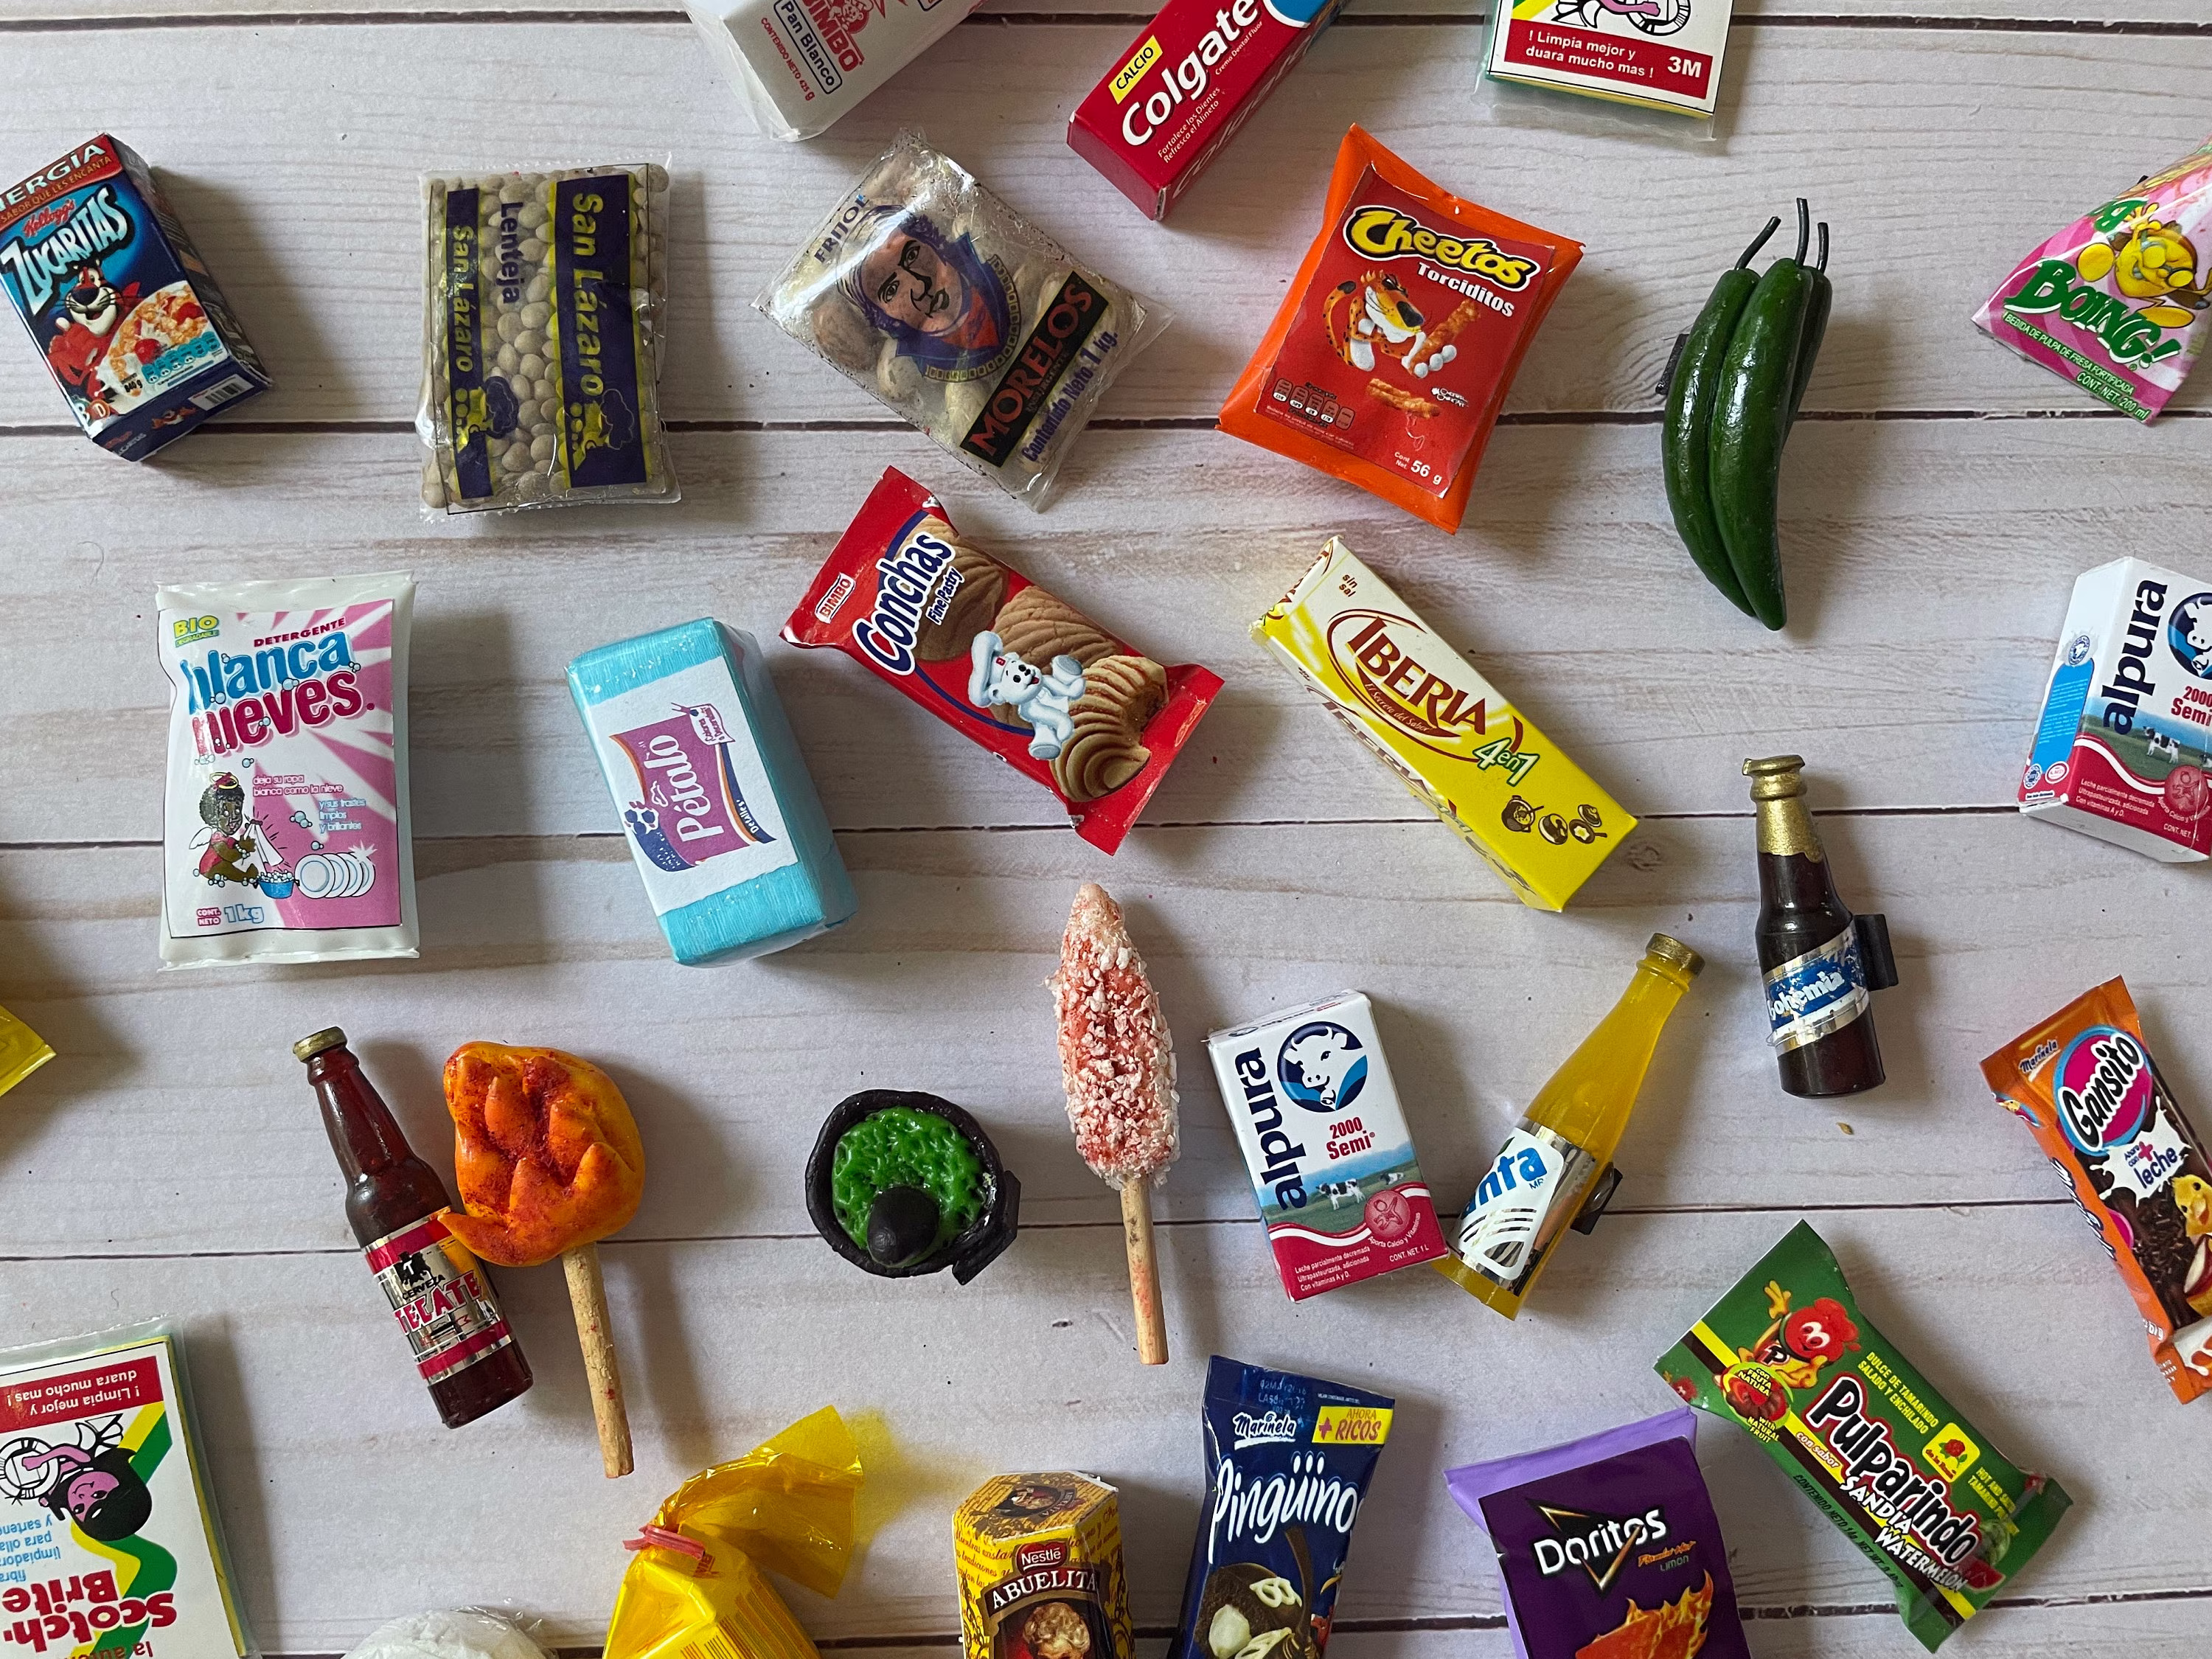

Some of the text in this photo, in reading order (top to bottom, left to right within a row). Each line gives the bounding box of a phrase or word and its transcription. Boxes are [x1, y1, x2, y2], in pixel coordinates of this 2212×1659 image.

[780, 3, 835, 86] Pan Blanco
[1231, 21, 1263, 58] Dental Fluor
[1537, 32, 1635, 60] Limpia mejor y
[761, 18, 790, 60] CONTENIDO
[787, 58, 801, 80] NETO
[805, 91, 815, 101] g
[1116, 46, 1154, 90] CALCIO
[1121, 0, 1258, 145] Colgate
[1526, 46, 1645, 76] duara mucho mas
[1668, 56, 1702, 78] 3M
[1158, 87, 1220, 158] Fortalece los Dientes
[1164, 130, 1192, 163] Refresca
[1189, 122, 1198, 134] el
[1, 156, 112, 223] SABOR QUE LES ENCANTA
[814, 195, 869, 264] FRIJOL
[1, 187, 128, 316] ZUCARITAS
[500, 201, 525, 305] Lenteja
[1351, 212, 1532, 285] Cheetos
[451, 224, 478, 371] San Lázaro
[572, 192, 609, 396] San Lázaro
[1416, 262, 1515, 318] Torciditos
[2004, 259, 2183, 369] BOING!
[967, 282, 1092, 456] MORELOS
[2028, 328, 2041, 339] DE
[2038, 335, 2061, 352] PULPA
[2059, 347, 2072, 358] DE
[2069, 352, 2093, 370] FRESA
[2090, 365, 2135, 394] FORTIFICADA
[1022, 397, 1071, 462] Contenido
[1062, 366, 1093, 400] Neto
[1080, 347, 1102, 366] 1
[2076, 372, 2151, 420] CONT. NET. 200 ml
[1394, 451, 1410, 463] Cont
[1411, 460, 1443, 485] 56 g
[927, 568, 963, 624] Fine Pastry
[1338, 582, 1357, 598] sal
[1341, 572, 1358, 588] sin
[820, 578, 852, 620] BIMBO
[855, 533, 953, 672] Conchas
[173, 615, 219, 637] BIO
[254, 618, 345, 647] DETERGENTE
[2101, 580, 2168, 734] alpura
[1347, 616, 1486, 735] IBERIA
[1364, 683, 1430, 732] El Secreto del Sabor
[2171, 698, 2212, 726] Semi
[273, 776, 282, 784] su
[284, 774, 304, 785] ropa
[284, 786, 309, 795] como
[310, 785, 319, 793] la
[321, 784, 344, 793] nieve
[645, 734, 724, 844] Pétalo
[196, 906, 221, 917] CONT.
[197, 915, 221, 927] NETO
[2020, 1039, 2059, 1074] Marinela
[2062, 1035, 2140, 1148] Gansito
[1235, 1047, 1310, 1211] alpura
[1326, 1130, 1372, 1160] Semi
[1329, 1116, 1363, 1139] 2000
[2128, 1157, 2140, 1168] con
[2133, 1147, 2178, 1189] leche
[1368, 1212, 1422, 1248] Aporta Calcio y Vitaminas
[1295, 1253, 1343, 1274] Leche parcialmente
[1343, 1256, 1369, 1269] adicionada
[1389, 1252, 1406, 1263] CONT.
[1407, 1247, 1420, 1257] NET.
[402, 1274, 445, 1300] CERVEZA
[1300, 1283, 1312, 1292] Con
[1312, 1276, 1336, 1289] vitaminas
[1335, 1273, 1340, 1281] A
[393, 1270, 483, 1336] TECATE
[15, 1369, 137, 1402] duara mucho mas
[1747, 1369, 1772, 1389] FRUTA
[1756, 1368, 1770, 1380] con
[1866, 1352, 1939, 1428] DULCE DE TAMARINDO
[29, 1388, 133, 1416] Limpia mejor y
[1346, 1408, 1377, 1419] AHORA
[1857, 1360, 1929, 1435] SALADO Y ENCHILADO
[1233, 1411, 1297, 1439] Marinela
[1335, 1419, 1382, 1441] RICOS
[1747, 1416, 1780, 1441] NATURAL
[1750, 1427, 1772, 1443] FRUIT
[1759, 1416, 1776, 1430] with
[1795, 1432, 1840, 1468] con sabor
[1808, 1376, 1980, 1564] Pulparindo
[1976, 1467, 1992, 1484] HOT
[1208, 1451, 1357, 1564] Pingüino
[1792, 1474, 1832, 1510] CONTENIDO
[1829, 1510, 1848, 1527] NETO
[24, 1530, 52, 1546] para
[46, 1514, 52, 1527] y
[1021, 1547, 1061, 1566] Nestlé
[1534, 1509, 1667, 1576] Doritos
[1874, 1526, 1968, 1593] WATERMELON
[1, 1569, 119, 1616] Brite
[992, 1570, 1096, 1610] ABUELITA
[133, 1641, 153, 1658] la
